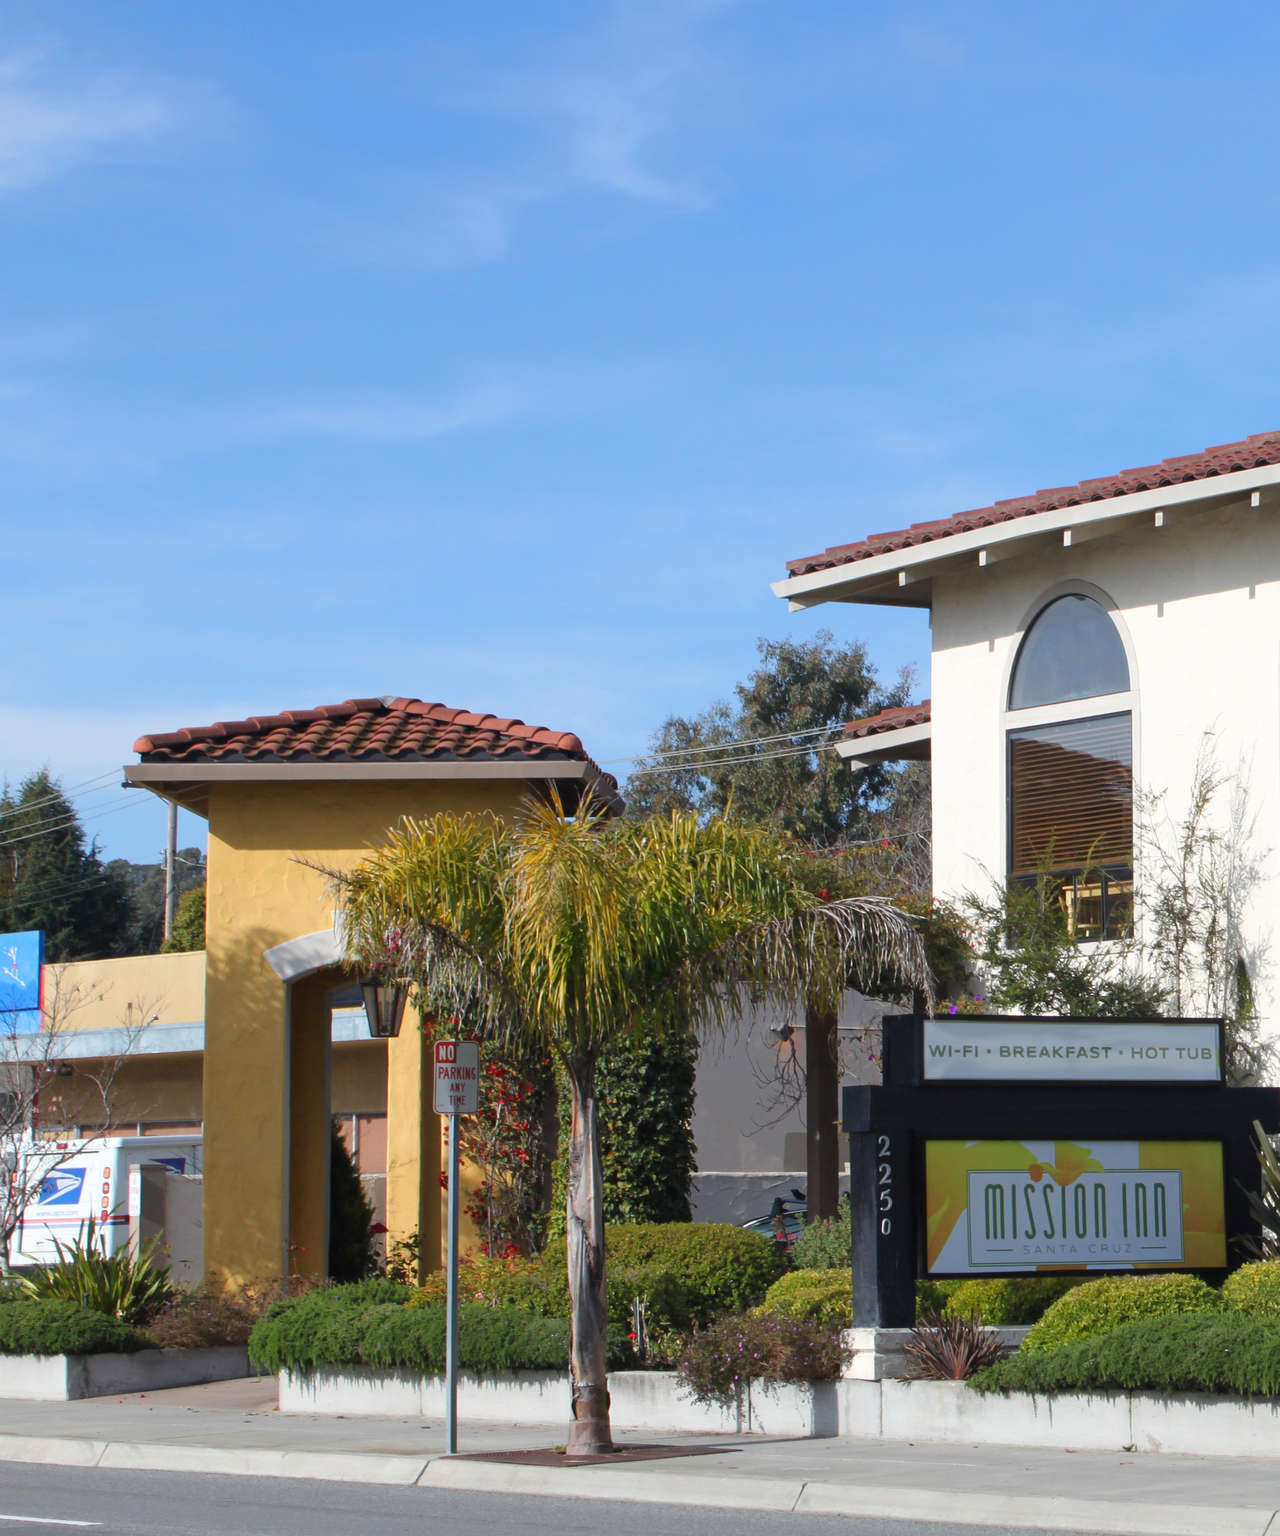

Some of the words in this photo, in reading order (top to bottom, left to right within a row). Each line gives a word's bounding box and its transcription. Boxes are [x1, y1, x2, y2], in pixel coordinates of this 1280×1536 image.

[439, 1045, 455, 1060] NO
[928, 1044, 979, 1058] WI-FI
[999, 1045, 1112, 1059] BREAKFAST
[1131, 1047, 1169, 1060] HOT
[1175, 1047, 1212, 1060] TUB
[438, 1066, 477, 1080] PARKING
[449, 1082, 466, 1093] ANY
[449, 1095, 466, 1106] TIME
[984, 1183, 1107, 1240] MISSION
[1122, 1182, 1167, 1238] INN
[1023, 1244, 1078, 1256] SANTA
[1088, 1243, 1132, 1255] CRUZ
